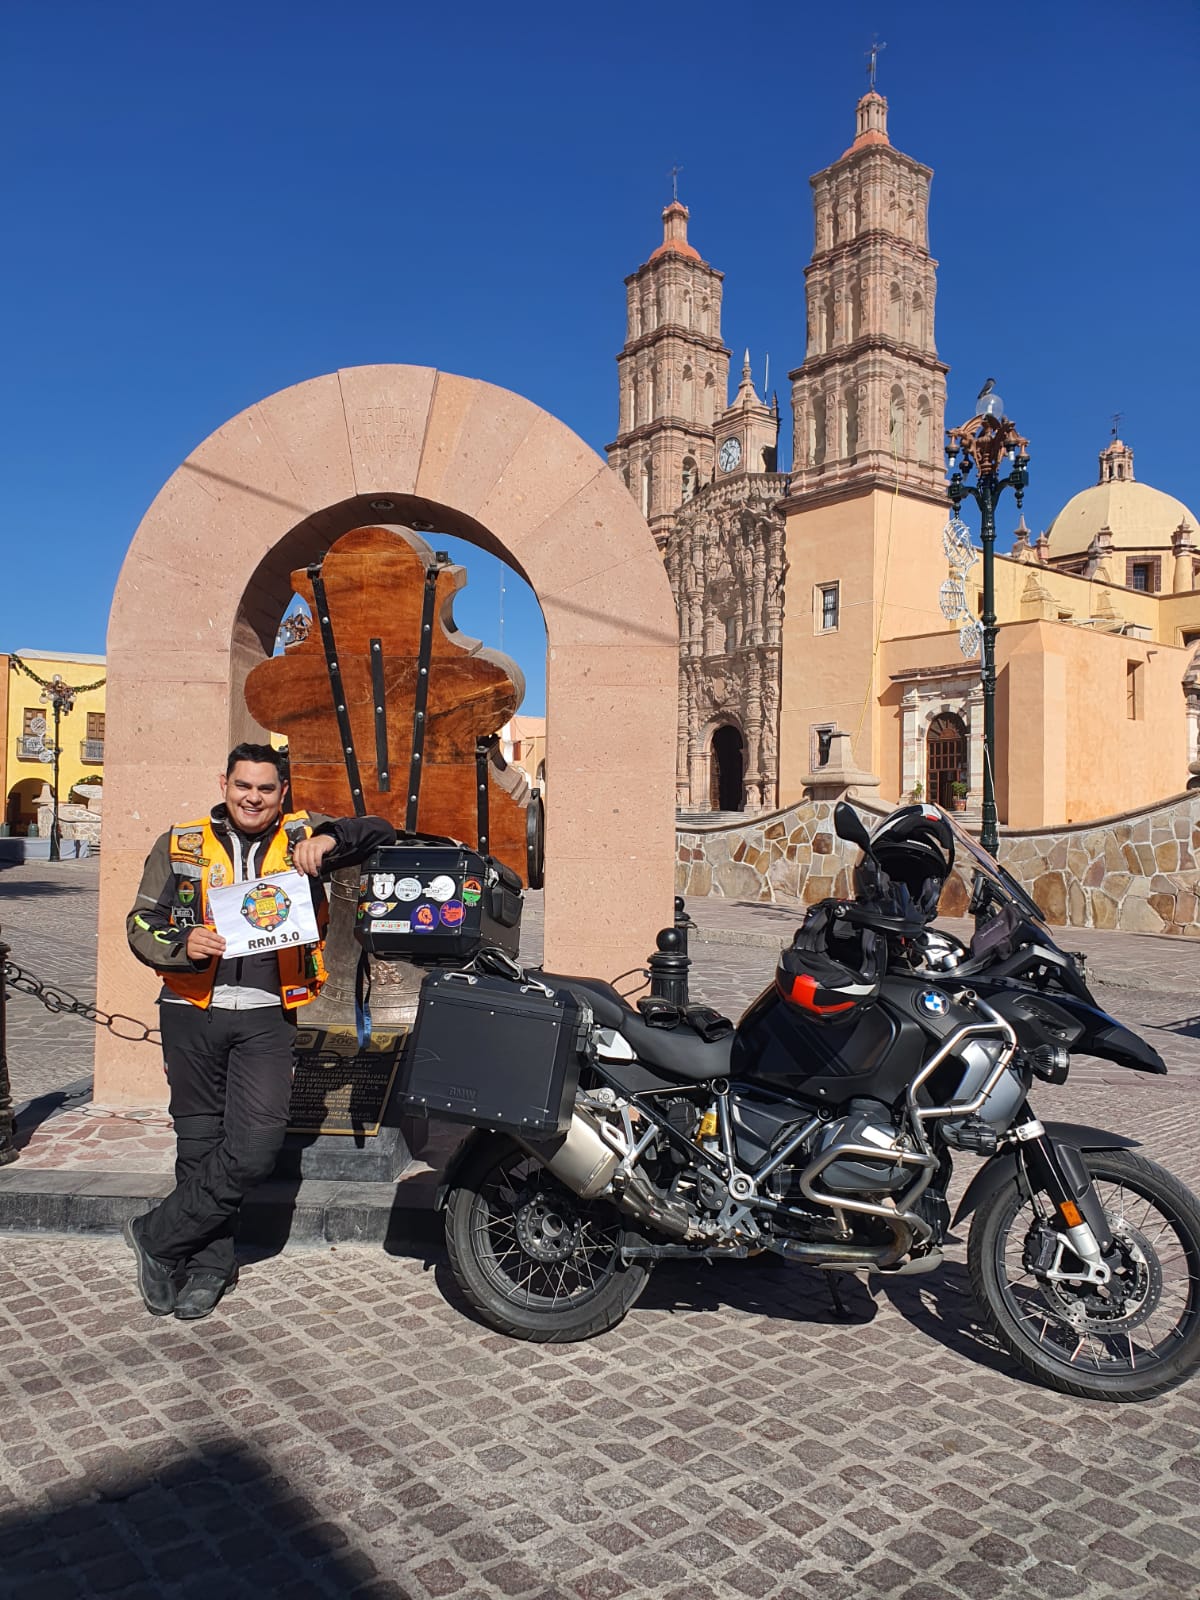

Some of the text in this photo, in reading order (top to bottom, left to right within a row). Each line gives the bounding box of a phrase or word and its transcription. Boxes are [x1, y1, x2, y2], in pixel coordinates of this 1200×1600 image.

[380, 882, 387, 895] 1
[248, 931, 300, 950] RRM 3.0
[449, 1086, 477, 1100] BMW
